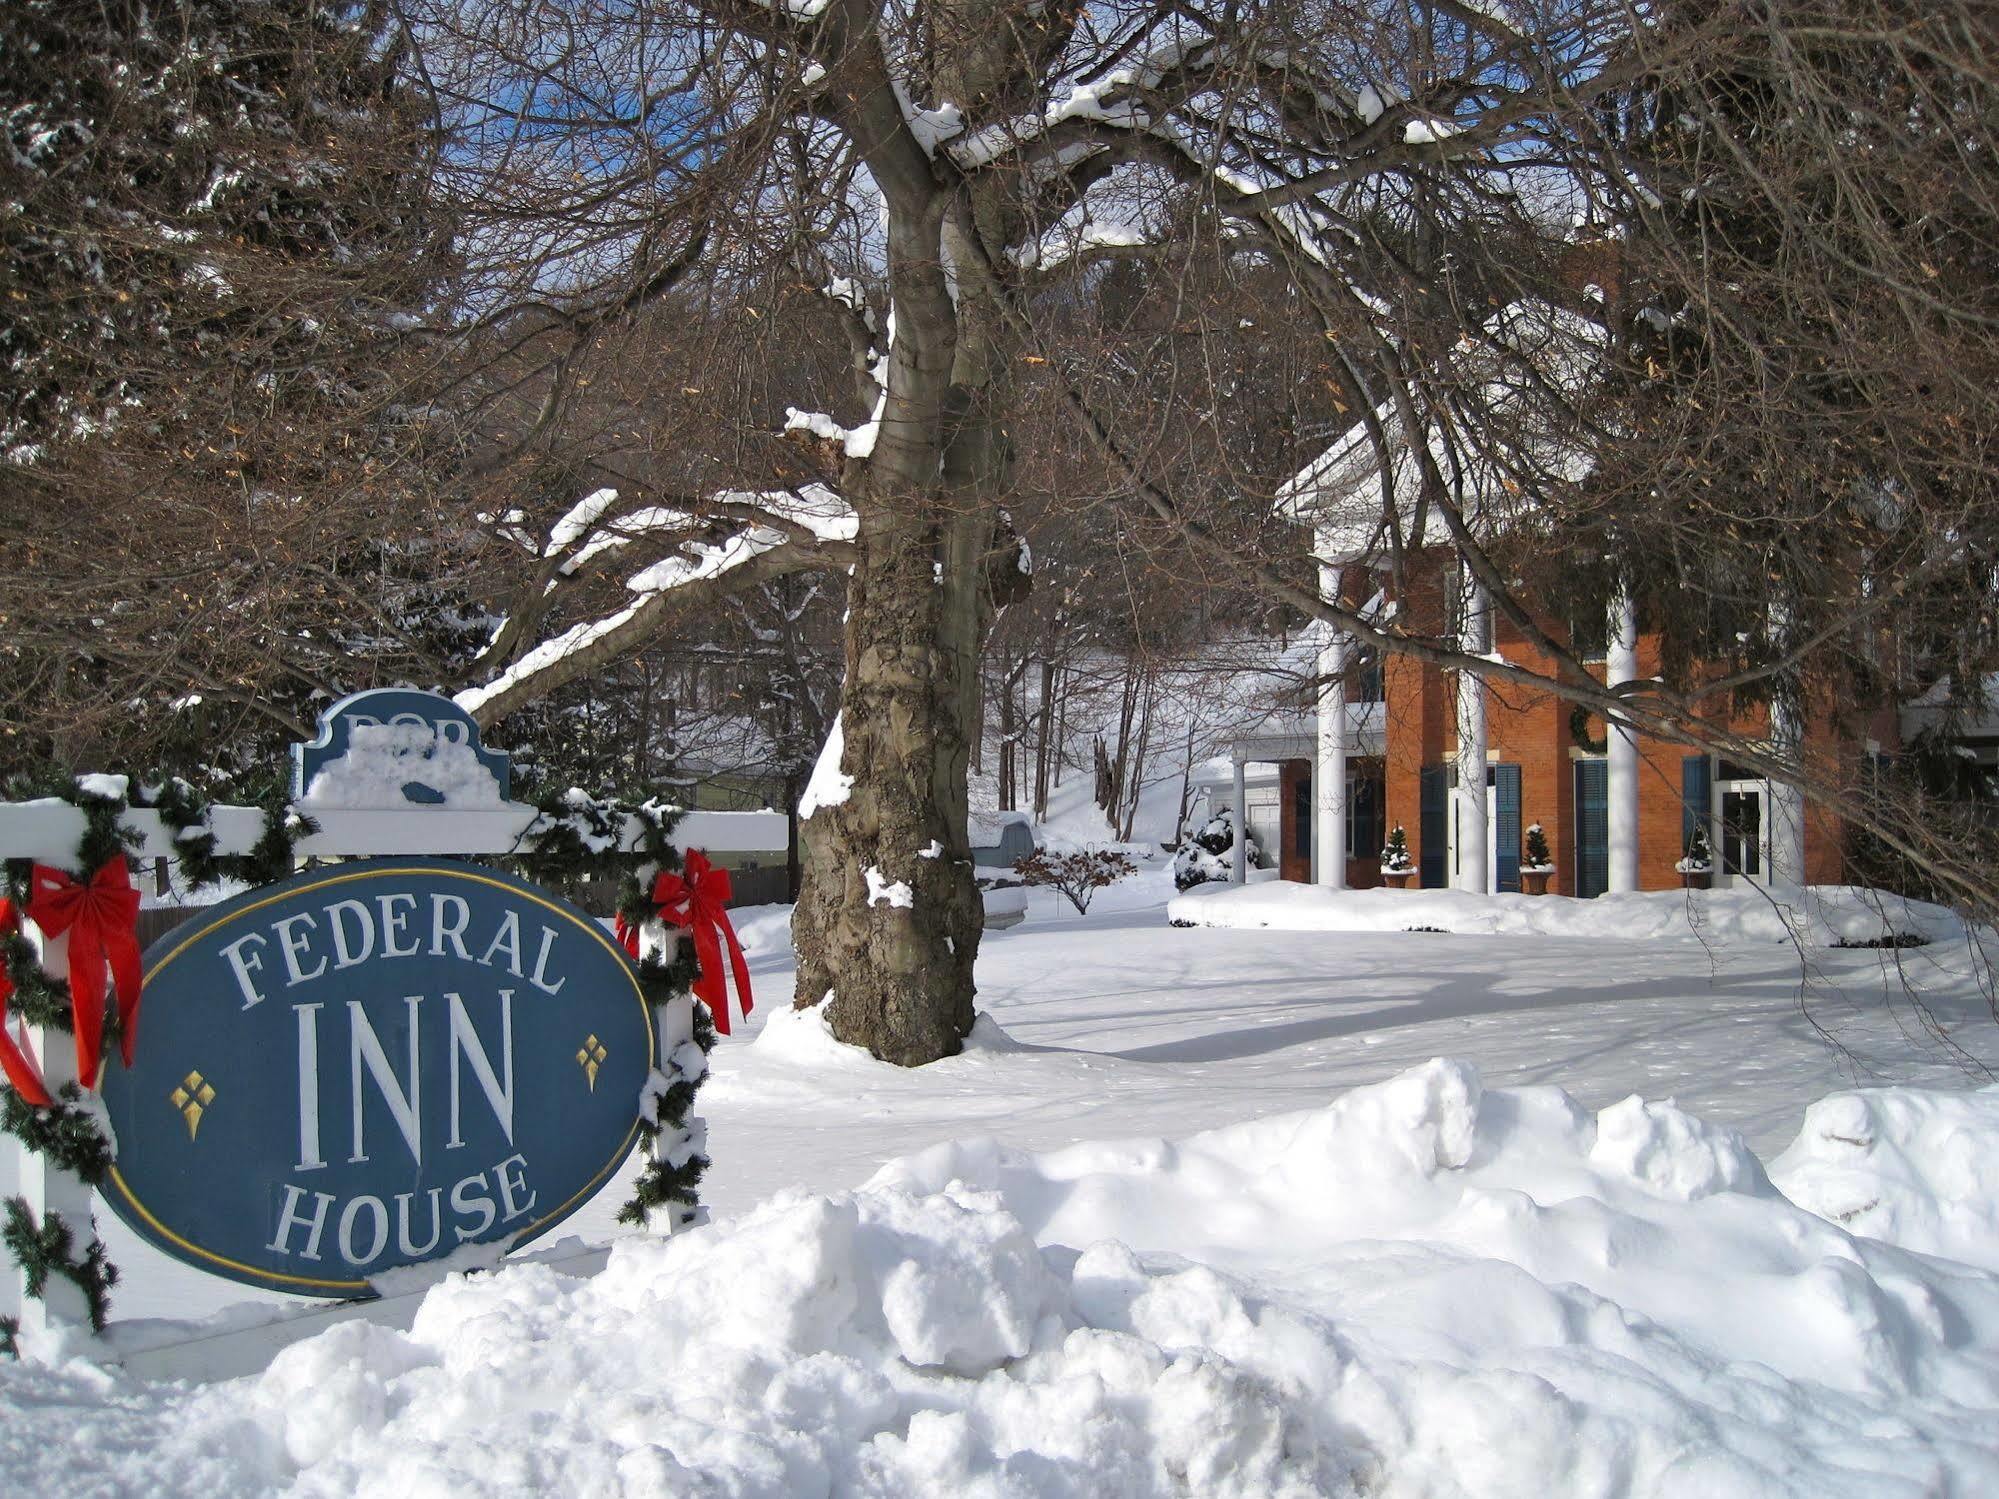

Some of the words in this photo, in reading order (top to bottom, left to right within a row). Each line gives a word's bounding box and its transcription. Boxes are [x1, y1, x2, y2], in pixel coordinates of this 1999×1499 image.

[218, 893, 566, 1011] FEDERAL
[292, 989, 516, 1172] INN
[266, 1153, 537, 1266] HOUSE
